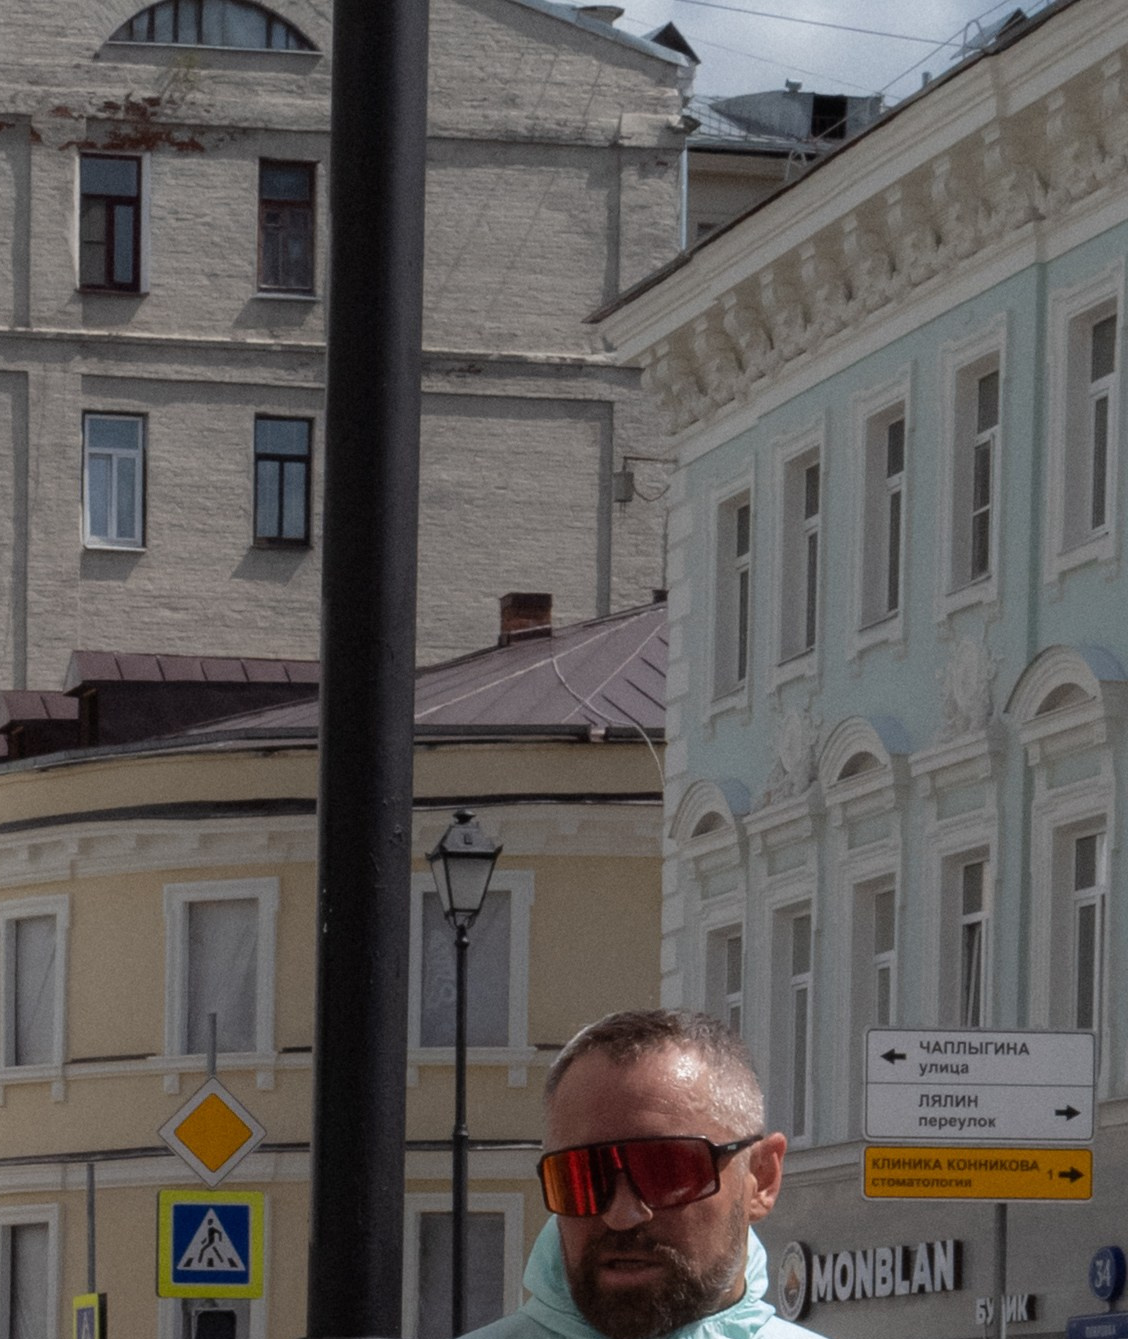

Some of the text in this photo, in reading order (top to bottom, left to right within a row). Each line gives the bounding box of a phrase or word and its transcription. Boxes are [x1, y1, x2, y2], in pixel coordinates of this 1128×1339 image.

[919, 1041, 1030, 1056] ЧАПЛЫГИНА
[919, 1062, 969, 1076] улица
[918, 1094, 979, 1109] ЛЯЛИН
[919, 1117, 996, 1130] переулок
[871, 1158, 1040, 1172] КЛИНИКА КОННИКОВА
[871, 1177, 972, 1189] стоматология
[812, 1239, 954, 1303] MONBLAN
[1094, 1258, 1112, 1288] 34
[975, 1294, 1029, 1325] БУИК
